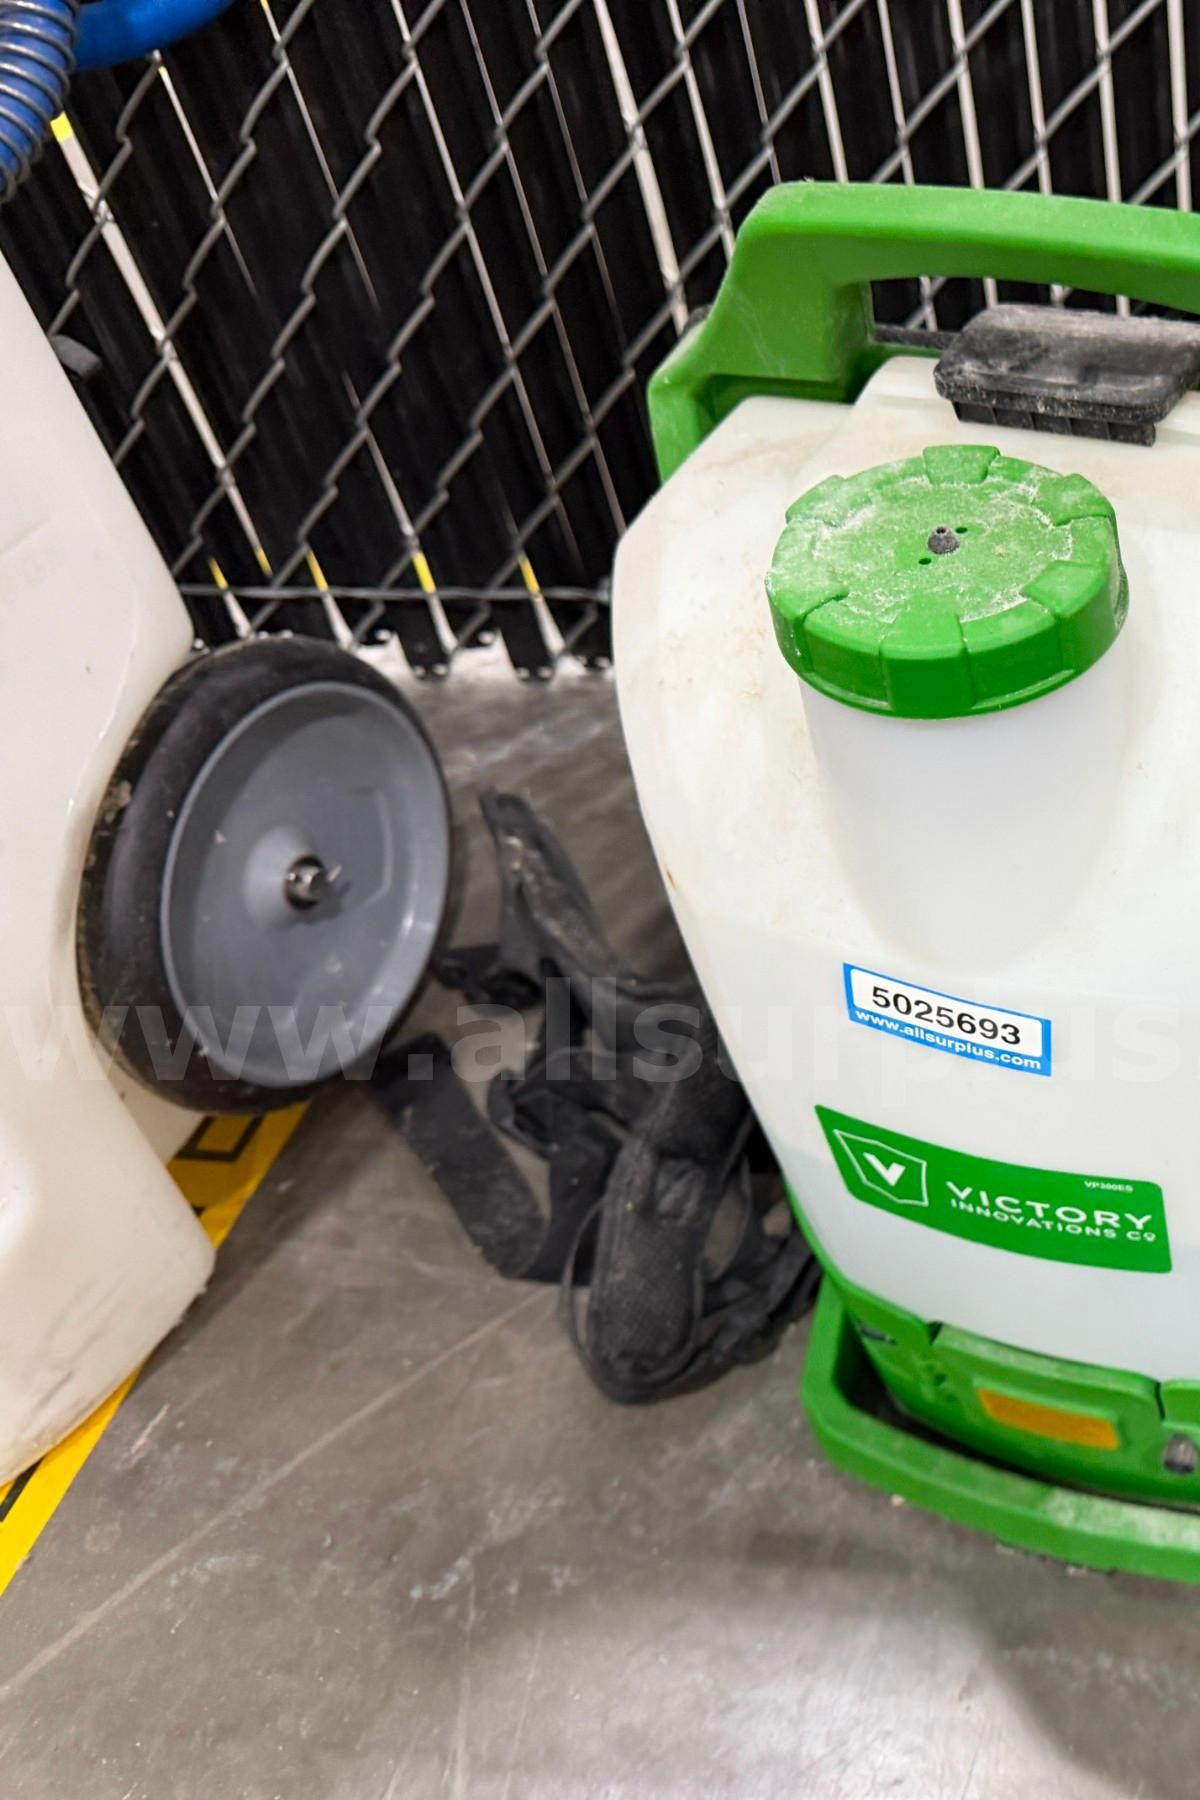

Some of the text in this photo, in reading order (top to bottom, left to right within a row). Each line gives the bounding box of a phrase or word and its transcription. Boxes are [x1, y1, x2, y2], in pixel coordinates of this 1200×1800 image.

[856, 1009, 1041, 1070] www.allsurplus.com
[872, 985, 1021, 1045] 5025693
[945, 1181, 1152, 1230] VICTORY
[950, 1198, 1117, 1240] INNOVATIONS
